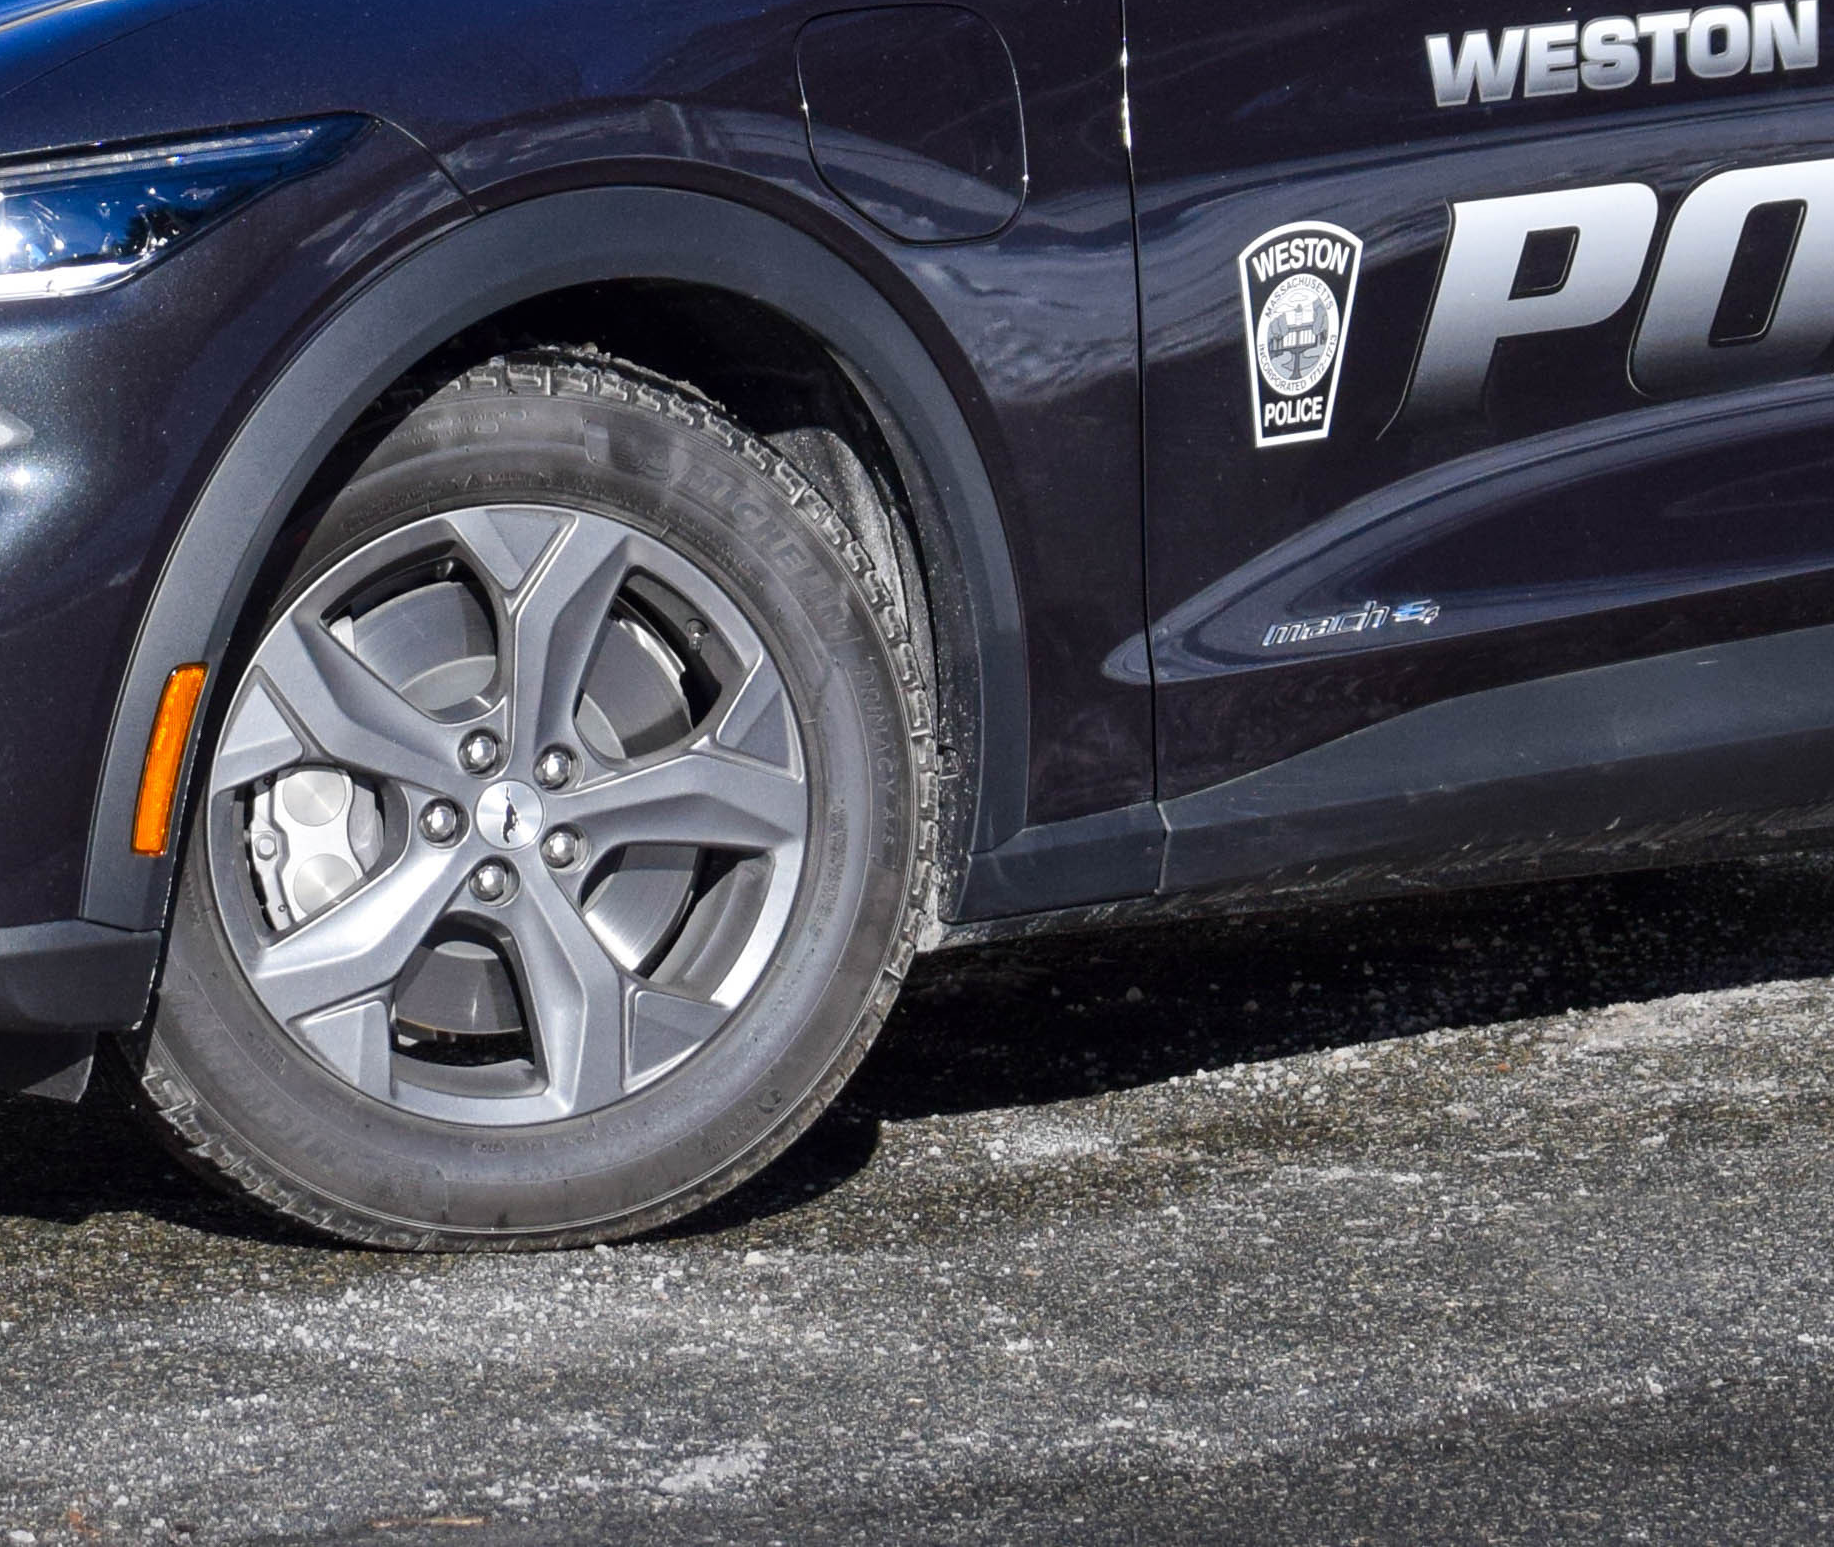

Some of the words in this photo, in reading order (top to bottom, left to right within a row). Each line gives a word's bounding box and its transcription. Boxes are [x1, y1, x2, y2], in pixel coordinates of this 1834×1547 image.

[1252, 237, 1350, 283] WESTON
[1264, 275, 1334, 319] MASSACHUSETTS
[1257, 342, 1307, 392] INCORPORATED
[1264, 396, 1324, 428] POLICE
